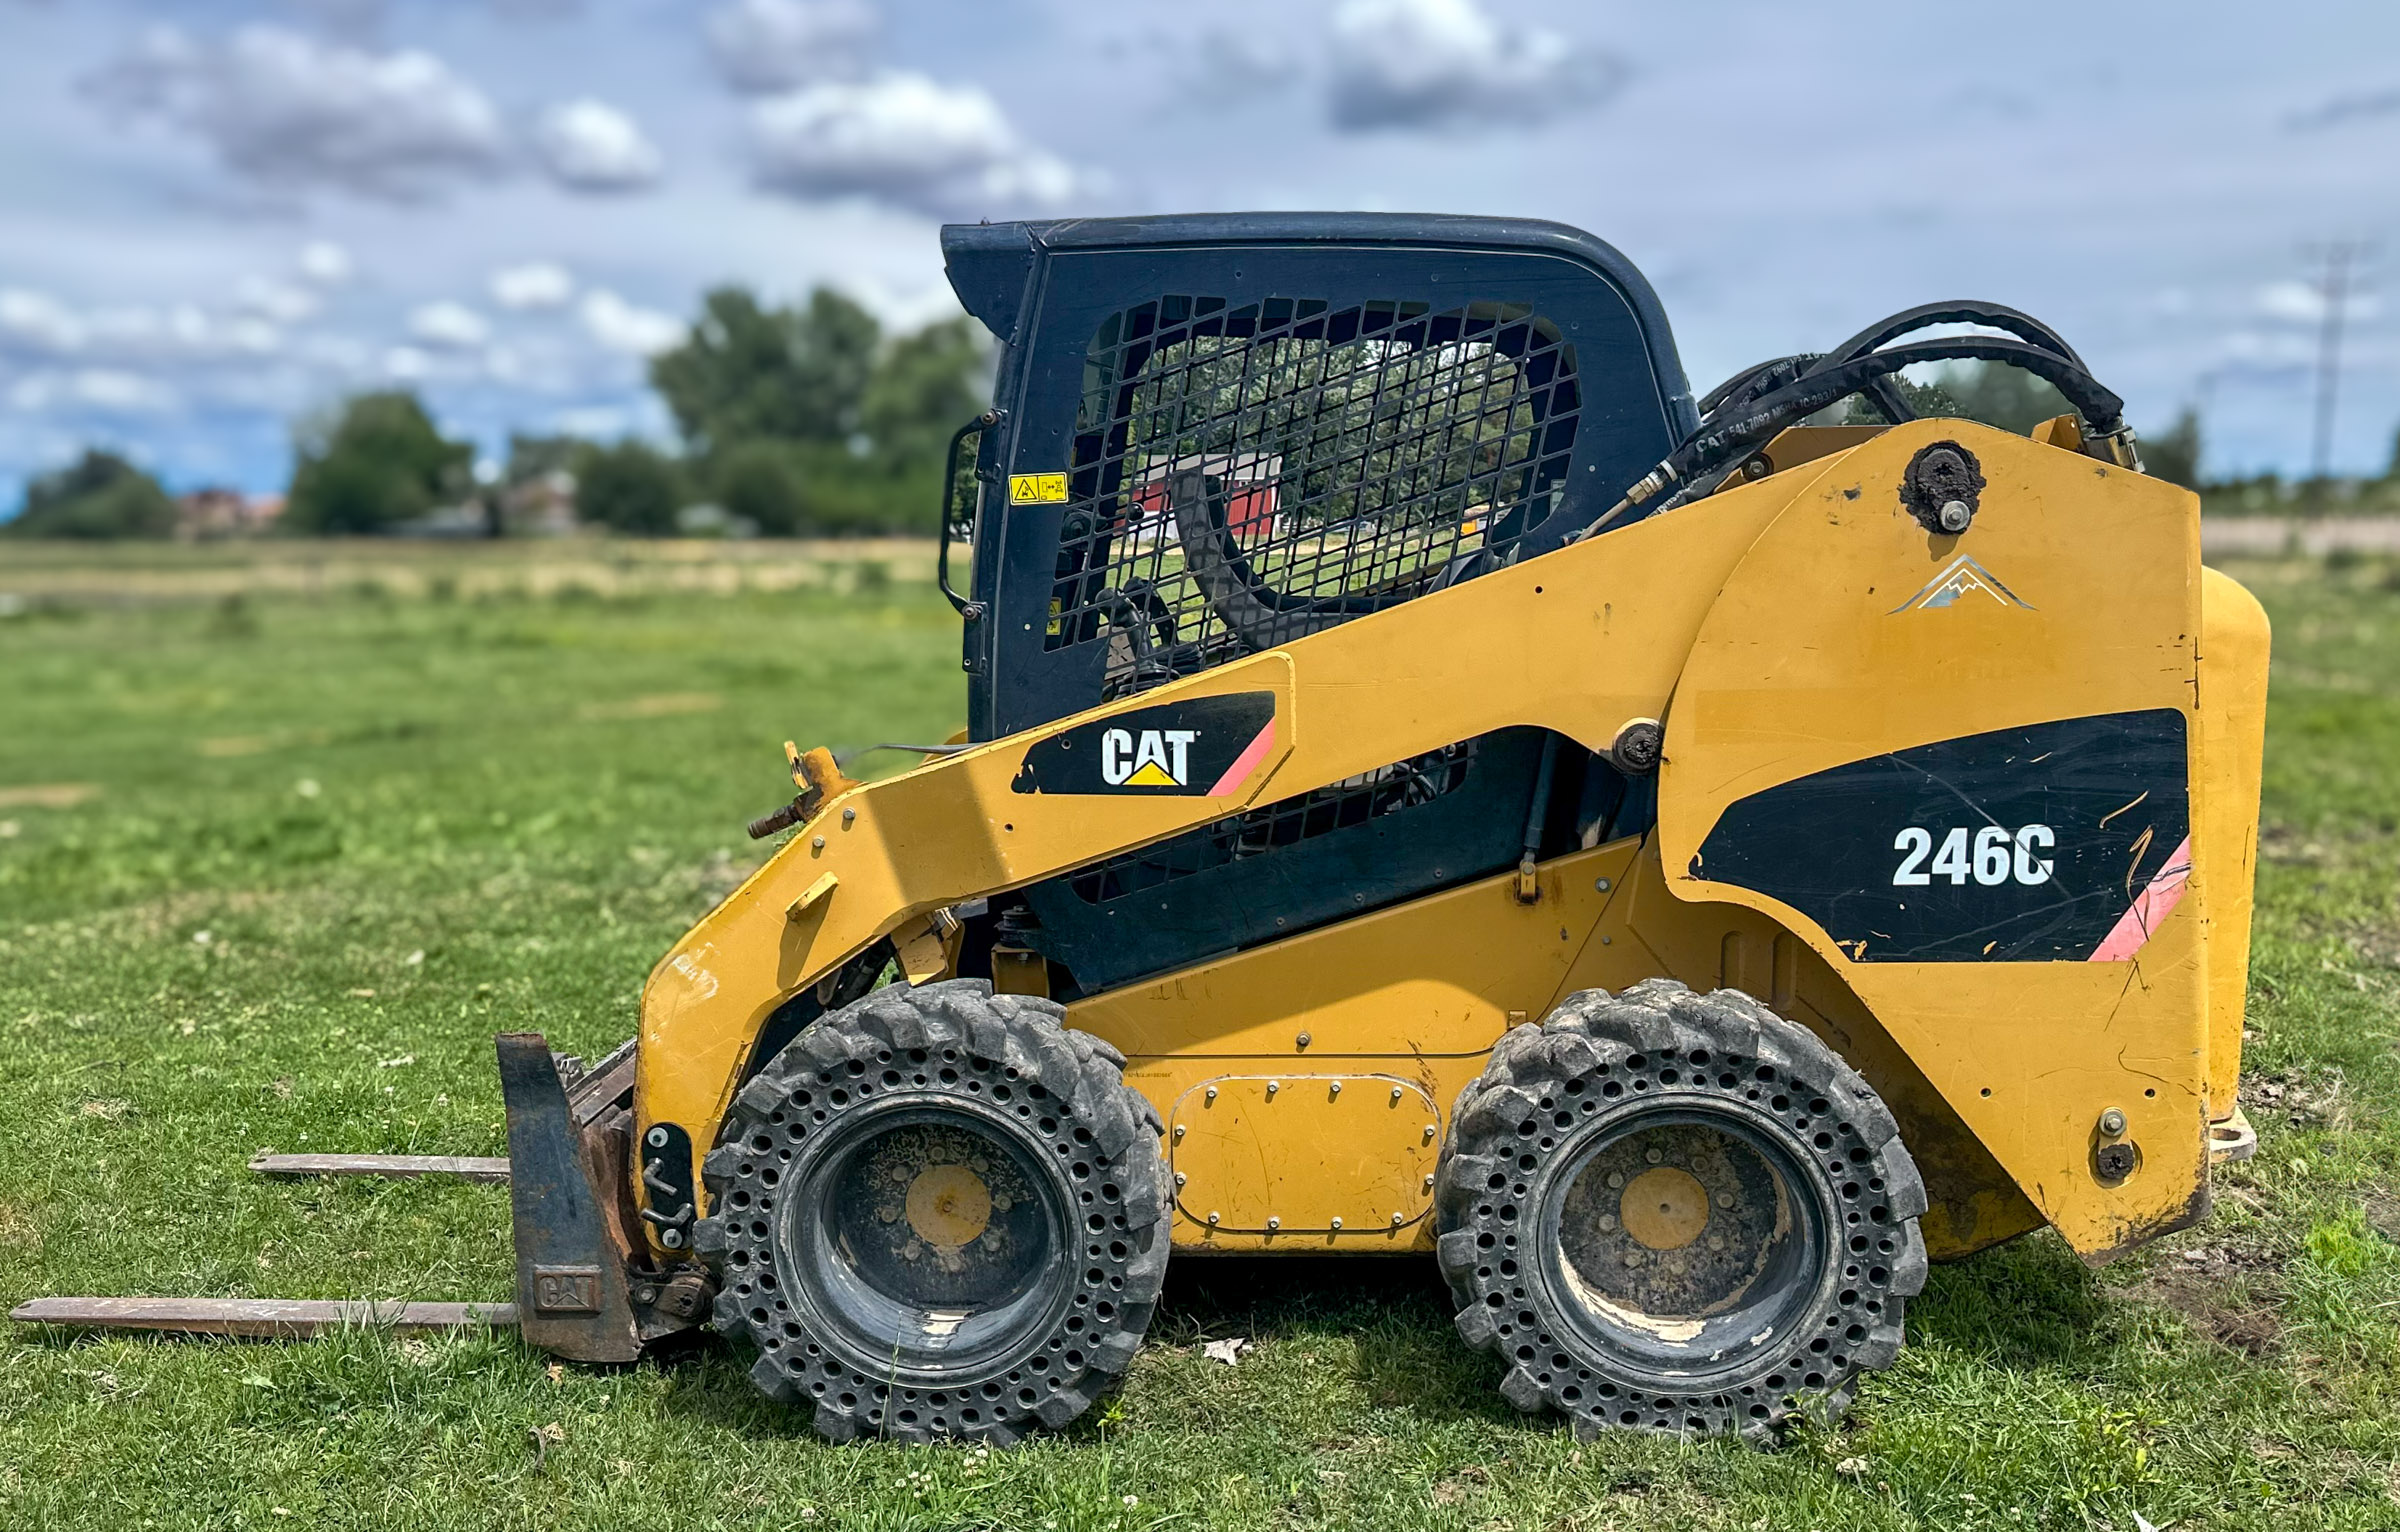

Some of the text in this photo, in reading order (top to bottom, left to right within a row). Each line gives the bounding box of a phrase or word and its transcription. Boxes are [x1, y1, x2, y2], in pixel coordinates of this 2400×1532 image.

[1695, 430, 1726, 453] CAT
[1102, 728, 1195, 786] CAT
[1892, 824, 2055, 886] 246C
[540, 1275, 593, 1308] CAT
